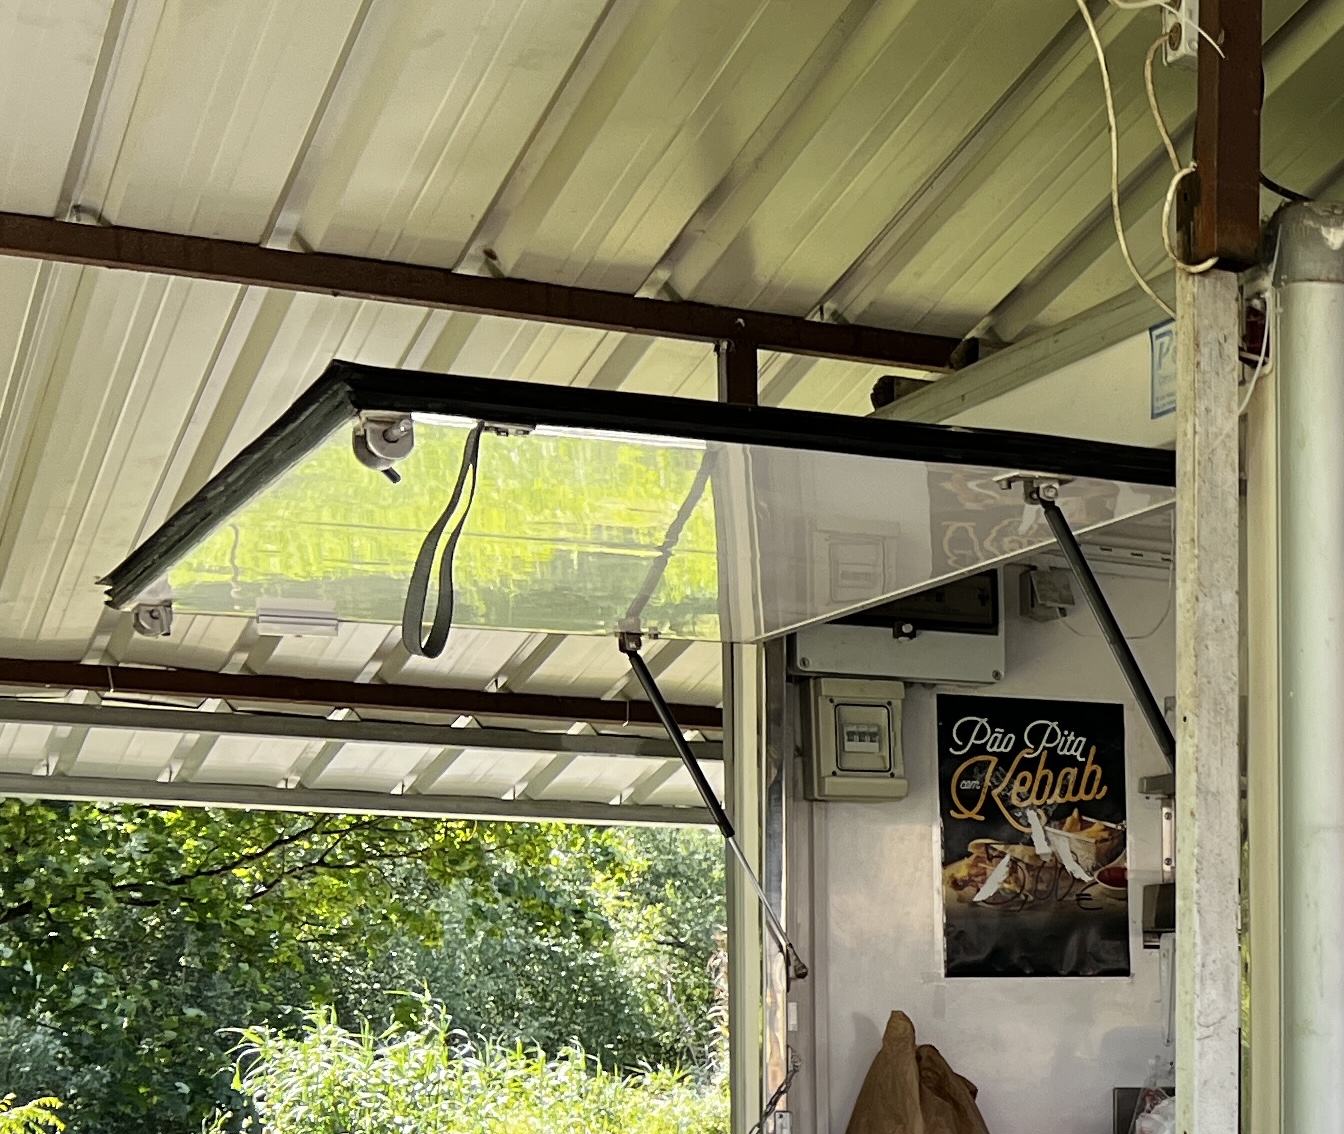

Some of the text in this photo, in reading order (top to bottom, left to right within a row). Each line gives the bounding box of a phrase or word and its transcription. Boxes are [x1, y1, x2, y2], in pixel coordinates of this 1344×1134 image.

[950, 716, 1086, 762] Pão Pita
[950, 746, 1108, 833] com Kebab
